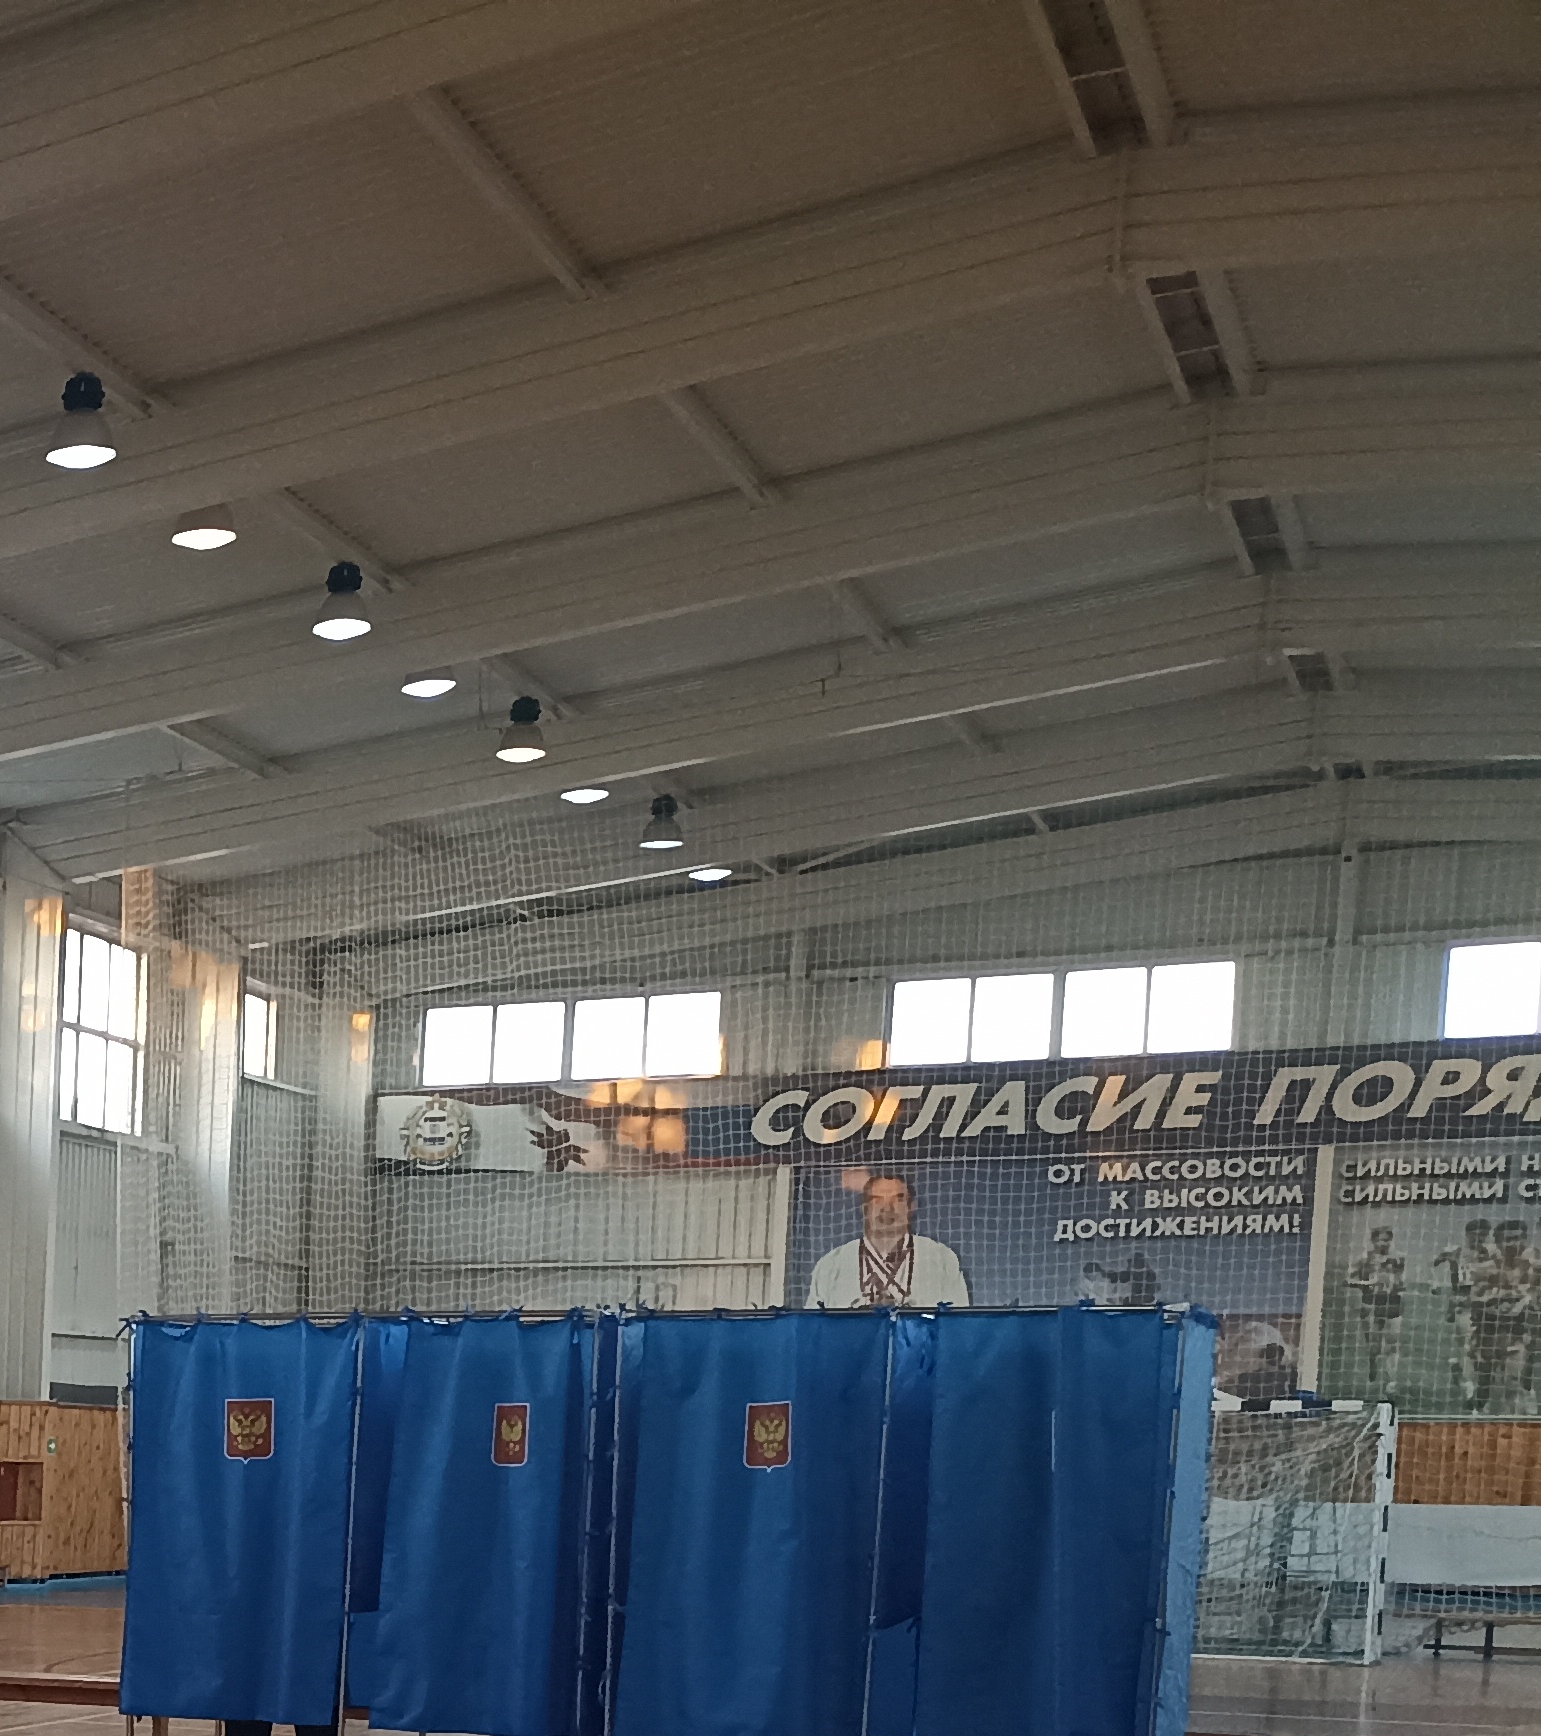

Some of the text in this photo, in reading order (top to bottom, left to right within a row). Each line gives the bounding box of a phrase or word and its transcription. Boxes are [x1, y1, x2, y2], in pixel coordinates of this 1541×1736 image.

[751, 1053, 1541, 1146] СОГЛАСИЕ ПОРЯ
[1048, 1156, 1305, 1184] ОТ МАССОВОСТИ
[1341, 1155, 1506, 1179] СИЛЬНЫМИ
[1110, 1184, 1304, 1210] К ВЫСОКИМ
[1339, 1178, 1504, 1203] СИЛЬНЫМИ
[1054, 1214, 1301, 1242] ДОСТИЖЕНИЯМ!
